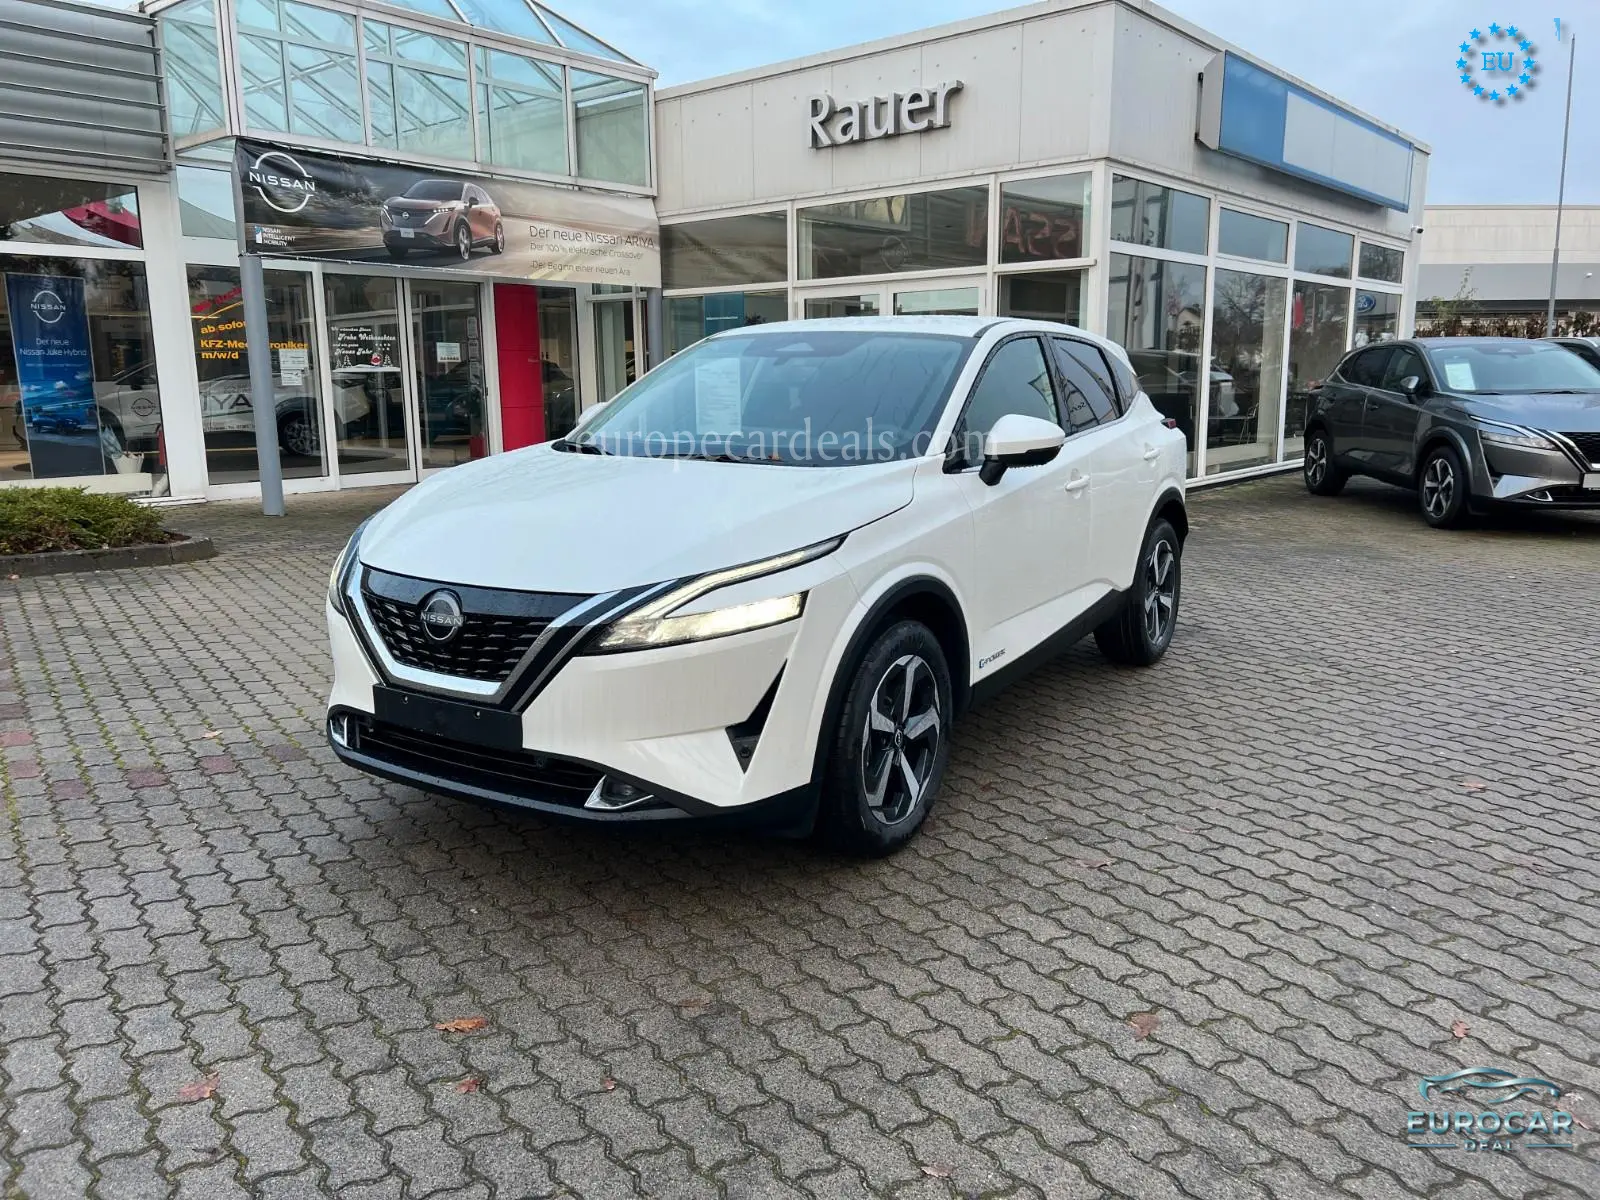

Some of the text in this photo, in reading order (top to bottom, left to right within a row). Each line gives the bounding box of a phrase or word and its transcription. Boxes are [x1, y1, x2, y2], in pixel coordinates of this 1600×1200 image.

[809, 80, 964, 149] Rauer
[249, 171, 316, 191] NISSAN
[529, 226, 655, 248] Der neue Nissan ARIYA
[200, 320, 247, 334] ab sofo
[200, 339, 309, 350] KFZ-Meroniker
[201, 351, 239, 359] m/w/d
[420, 611, 463, 626] NISSAN
